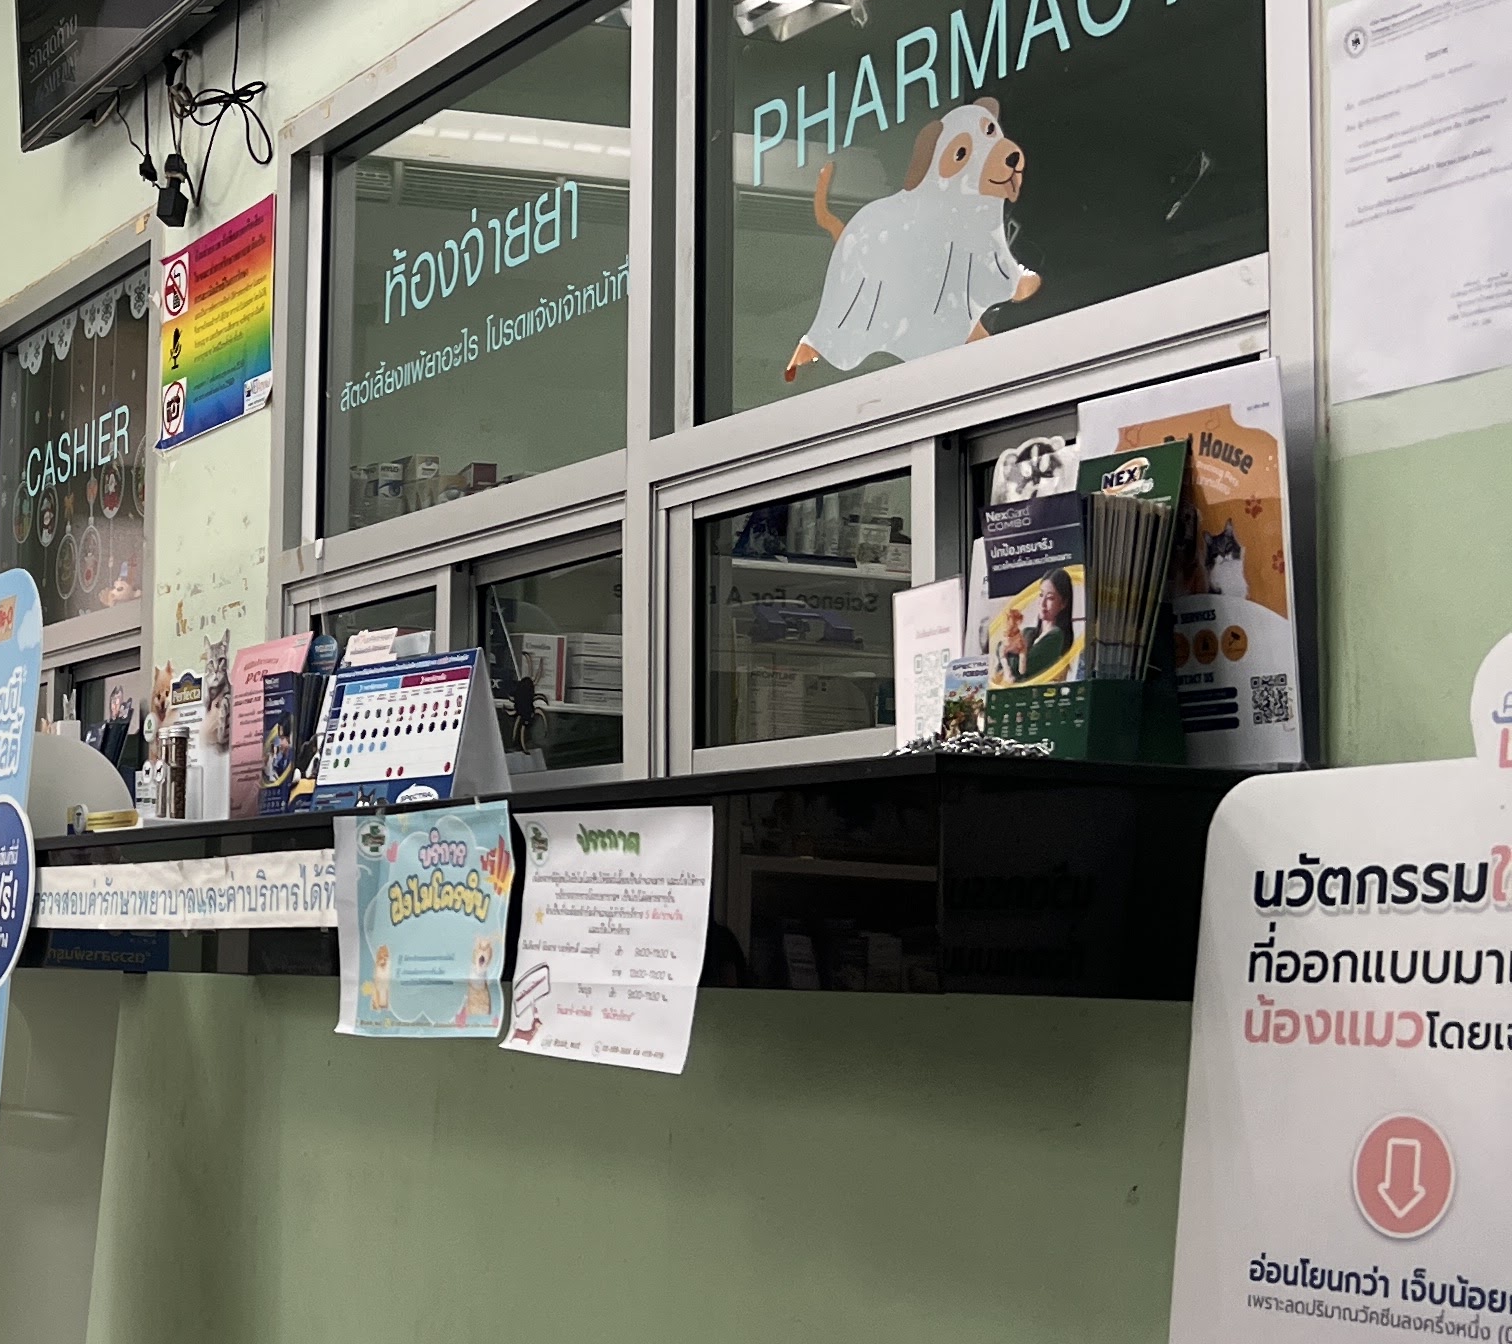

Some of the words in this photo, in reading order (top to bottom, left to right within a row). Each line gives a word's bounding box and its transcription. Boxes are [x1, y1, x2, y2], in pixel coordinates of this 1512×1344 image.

[384, 180, 578, 324] ห้องจ่ายยา
[340, 328, 478, 412] สัตว์เลี้ยงแพ้ยาอะไร
[26, 405, 130, 497] CASHIER
[1199, 431, 1253, 474] House
[1249, 1253, 1390, 1299] อ่อนโยนกว่า
[1402, 1268, 1512, 1315] เจ็บน้อย
